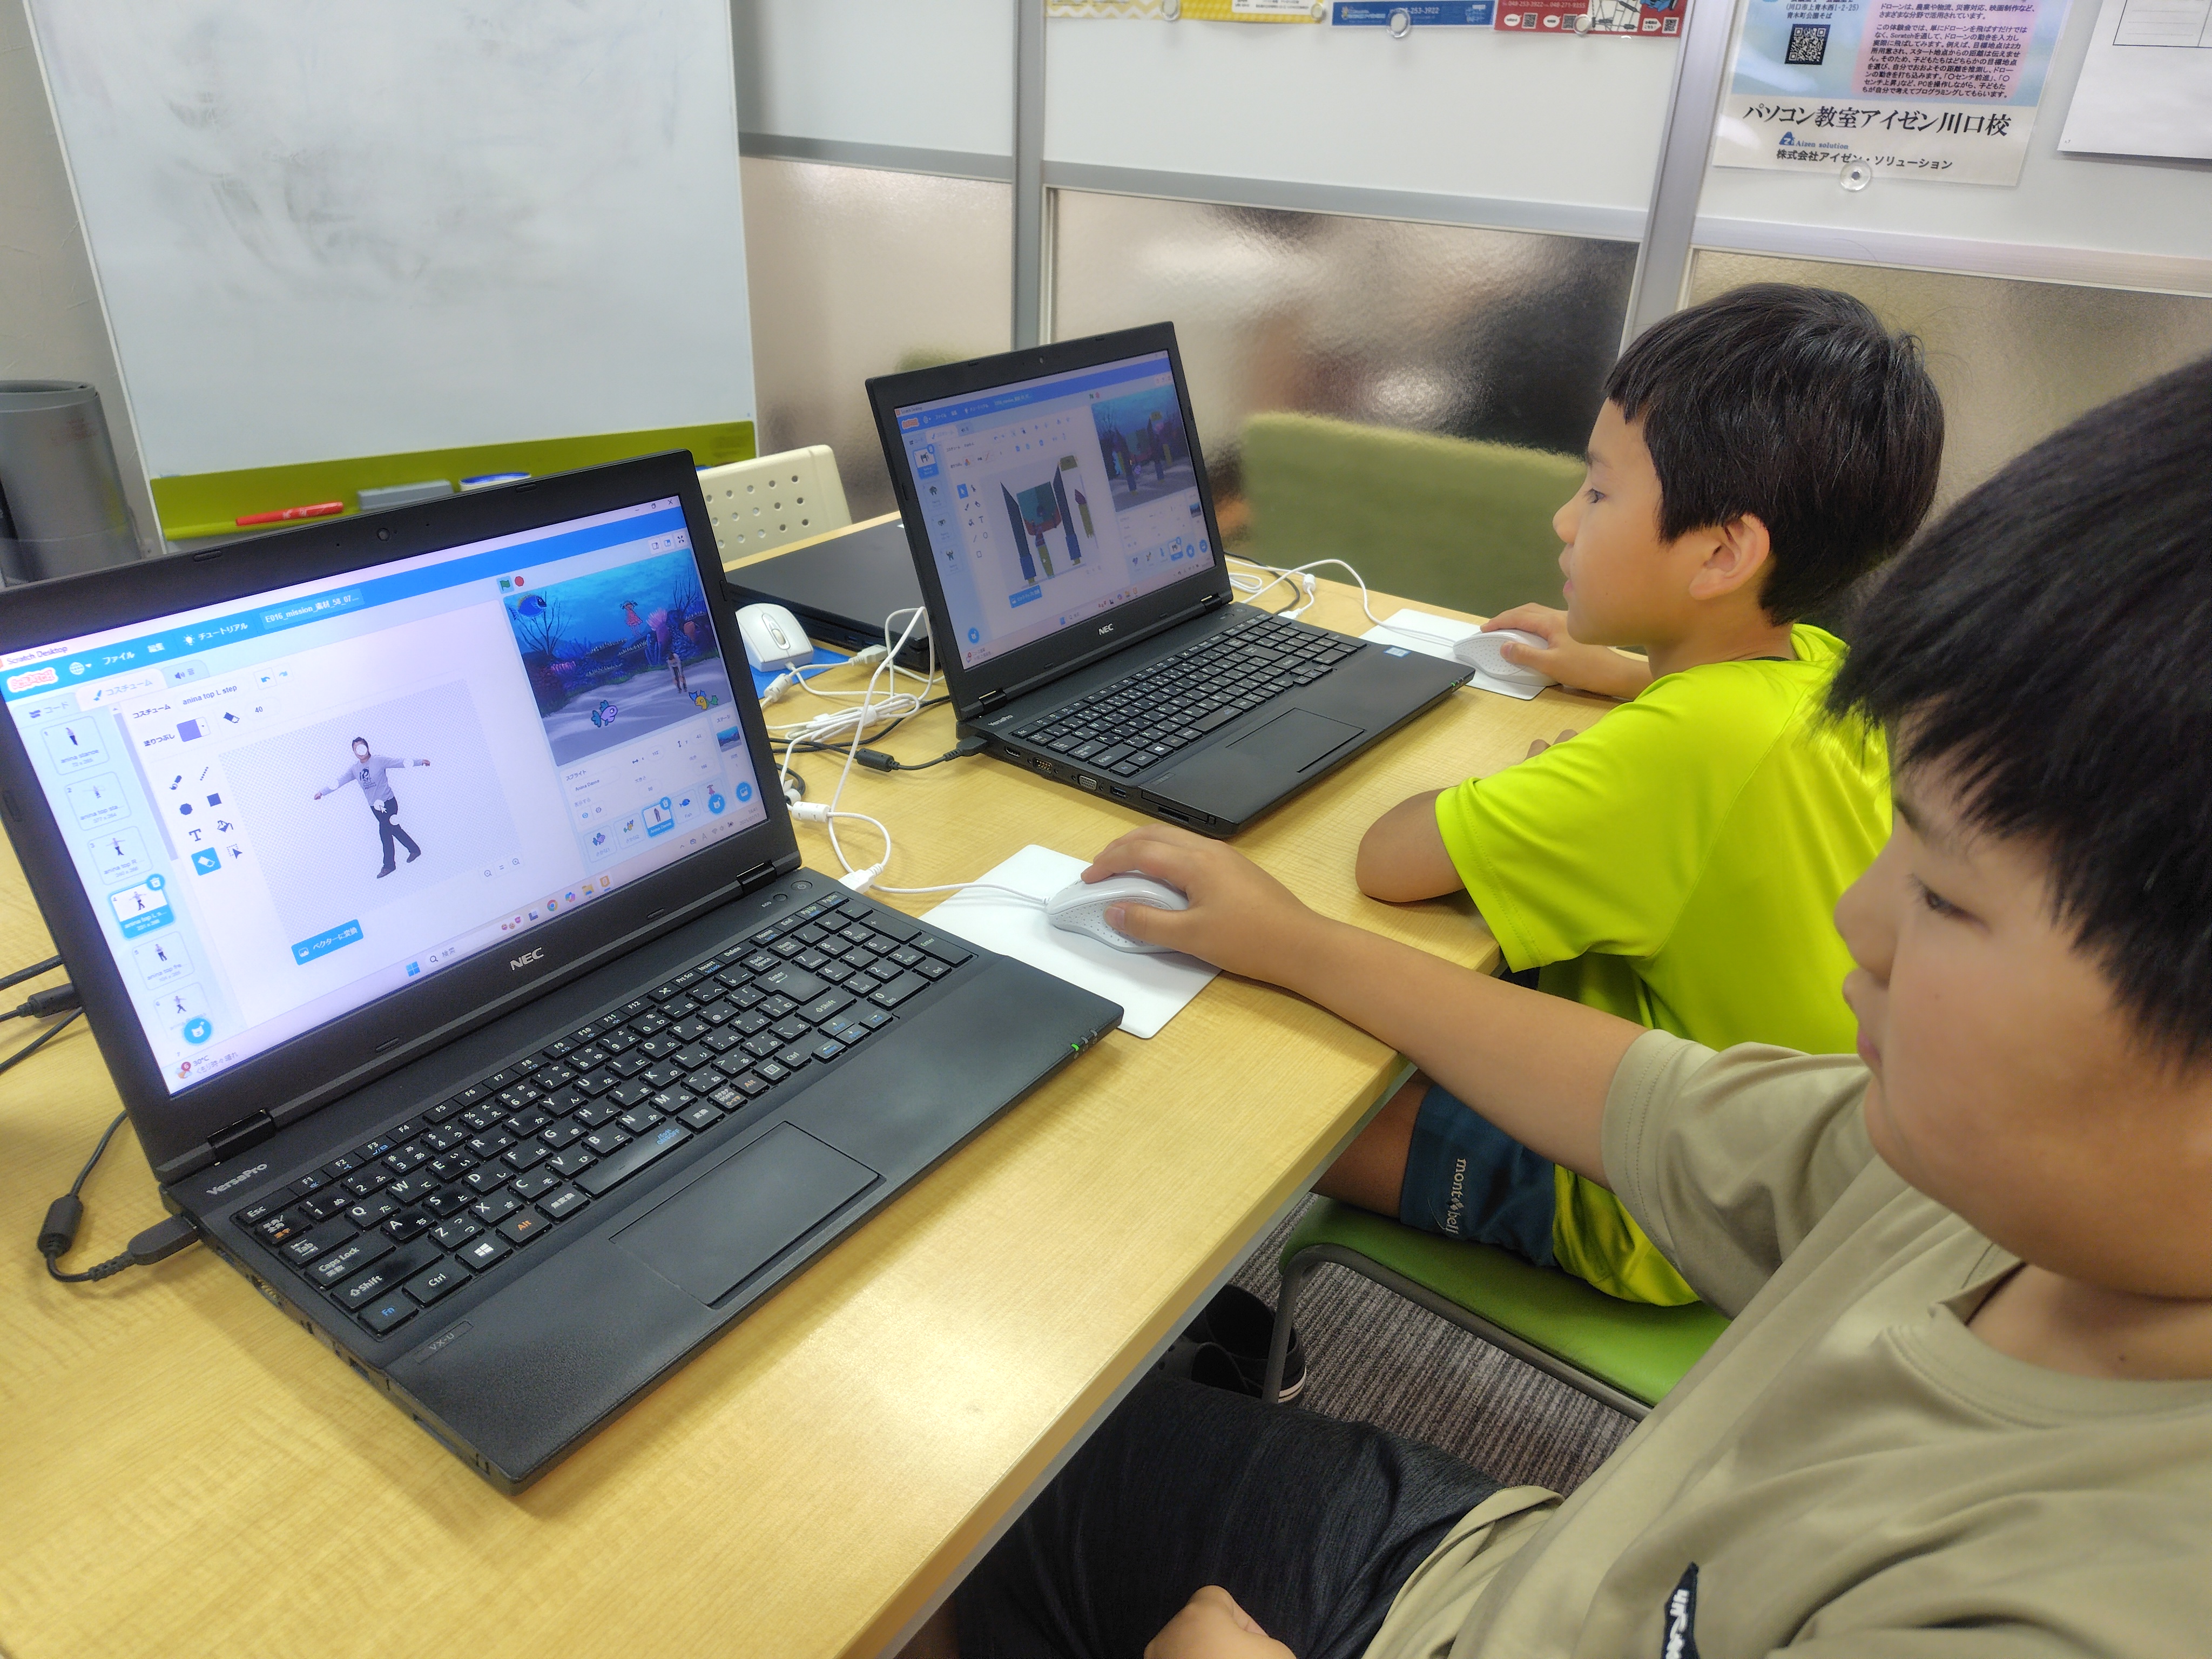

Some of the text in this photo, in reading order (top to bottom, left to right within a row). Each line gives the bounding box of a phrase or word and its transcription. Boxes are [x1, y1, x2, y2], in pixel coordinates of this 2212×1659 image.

[1743, 102, 2012, 137] パソコン教室アイゼン川口校
[1818, 141, 1849, 150] solution
[1776, 149, 1953, 170] 株式会社アイゼン・ソリューション
[198, 622, 248, 640] チュートリアル
[1098, 623, 1114, 635] NEC
[7, 646, 68, 665] Scratch Desktop
[102, 651, 135, 665] ファイル
[105, 679, 153, 696] コスチューム
[183, 695, 203, 705] anina
[222, 685, 238, 694] step
[44, 702, 69, 714] コード
[132, 704, 171, 719] コスチューム
[781, 918, 793, 926] End
[313, 927, 358, 950] ベクターに変換
[756, 928, 773, 939] Home
[723, 946, 741, 957] Delete
[510, 947, 544, 970] NEC
[697, 960, 716, 973] Insert
[768, 971, 785, 982] Enter
[628, 1001, 641, 1010] F12
[821, 999, 837, 1008] Shift
[578, 1027, 591, 1036] F10
[644, 1042, 655, 1050] O
[193, 1055, 210, 1067] 30°C
[786, 1051, 800, 1061] Ctrl
[521, 1059, 532, 1067] F8
[494, 1074, 503, 1082] F7
[644, 1071, 658, 1080] K
[577, 1078, 590, 1087] U
[744, 1080, 756, 1088] Alt
[615, 1090, 623, 1098] J
[655, 1094, 671, 1104] M
[543, 1097, 555, 1106] Y
[435, 1104, 446, 1112] F5
[579, 1109, 592, 1118] H
[508, 1117, 520, 1127] T
[622, 1115, 636, 1124] N
[398, 1124, 410, 1133] F4
[544, 1129, 557, 1138] G
[471, 1139, 485, 1148] R
[588, 1136, 601, 1145] B
[367, 1142, 379, 1150] F3
[507, 1151, 517, 1160] F
[551, 1156, 564, 1165] V
[335, 1159, 347, 1167] F2
[433, 1161, 446, 1170] E
[206, 1163, 267, 1196] VersaPro
[302, 1177, 314, 1185] F1
[468, 1173, 481, 1183] D
[392, 1181, 409, 1192] W
[516, 1179, 529, 1188] C
[430, 1196, 442, 1205] S
[1445, 1158, 1467, 1234] mont bell
[247, 1205, 266, 1217] Esc
[352, 1206, 367, 1216] Q
[475, 1202, 490, 1213] X
[389, 1220, 403, 1230] A
[517, 1219, 532, 1231] Alt
[435, 1227, 449, 1237] Z
[295, 1242, 314, 1254] Tab
[319, 1246, 360, 1272] Caps Lock
[358, 1274, 383, 1292] Shift
[428, 1273, 447, 1287] Ctrl
[382, 1306, 395, 1316] Fn
[429, 1332, 455, 1350] VX-U
